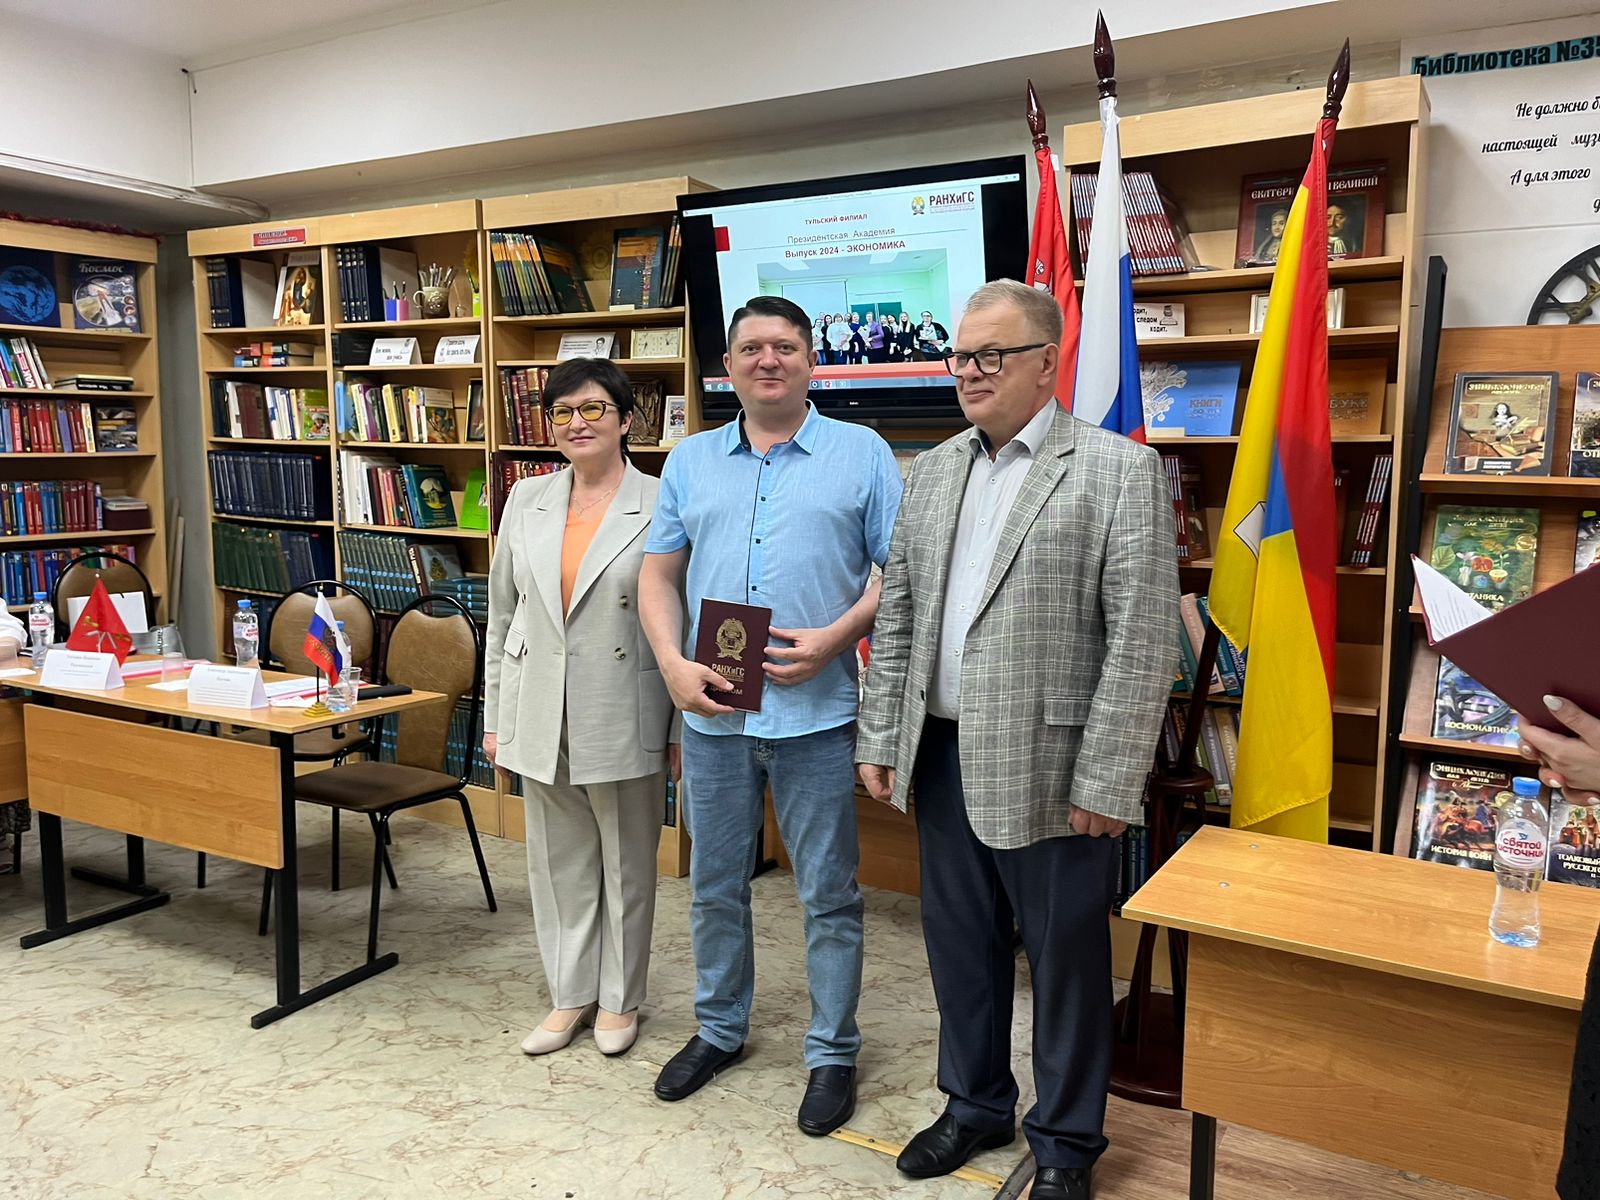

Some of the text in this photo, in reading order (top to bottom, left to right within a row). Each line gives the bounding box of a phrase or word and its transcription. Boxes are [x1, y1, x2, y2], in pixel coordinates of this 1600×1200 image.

[1413, 46, 1550, 78] Библиотека
[1515, 96, 1600, 120] Не должно б
[1481, 133, 1600, 153] настоящей муз
[1510, 168, 1591, 187] А для этого
[1251, 187, 1295, 199] ЕКАТЕРИ
[1332, 176, 1379, 190] ВЕЛИКИЙ
[929, 191, 975, 207] РАНХиГС
[805, 213, 868, 225] ТУЛЬСКИЙ ФИЛИАЛ
[787, 227, 896, 245] Президентская Академия
[785, 248, 817, 259] Выпуск
[819, 246, 839, 256] 2024
[847, 240, 906, 253] ЭКОНОМИКА
[78, 263, 124, 273] Космос
[1467, 592, 1504, 602] ТАНИКА
[711, 663, 745, 677] РАНХиГС
[1431, 845, 1492, 861] ИСТОРИЯ ВОЙН
